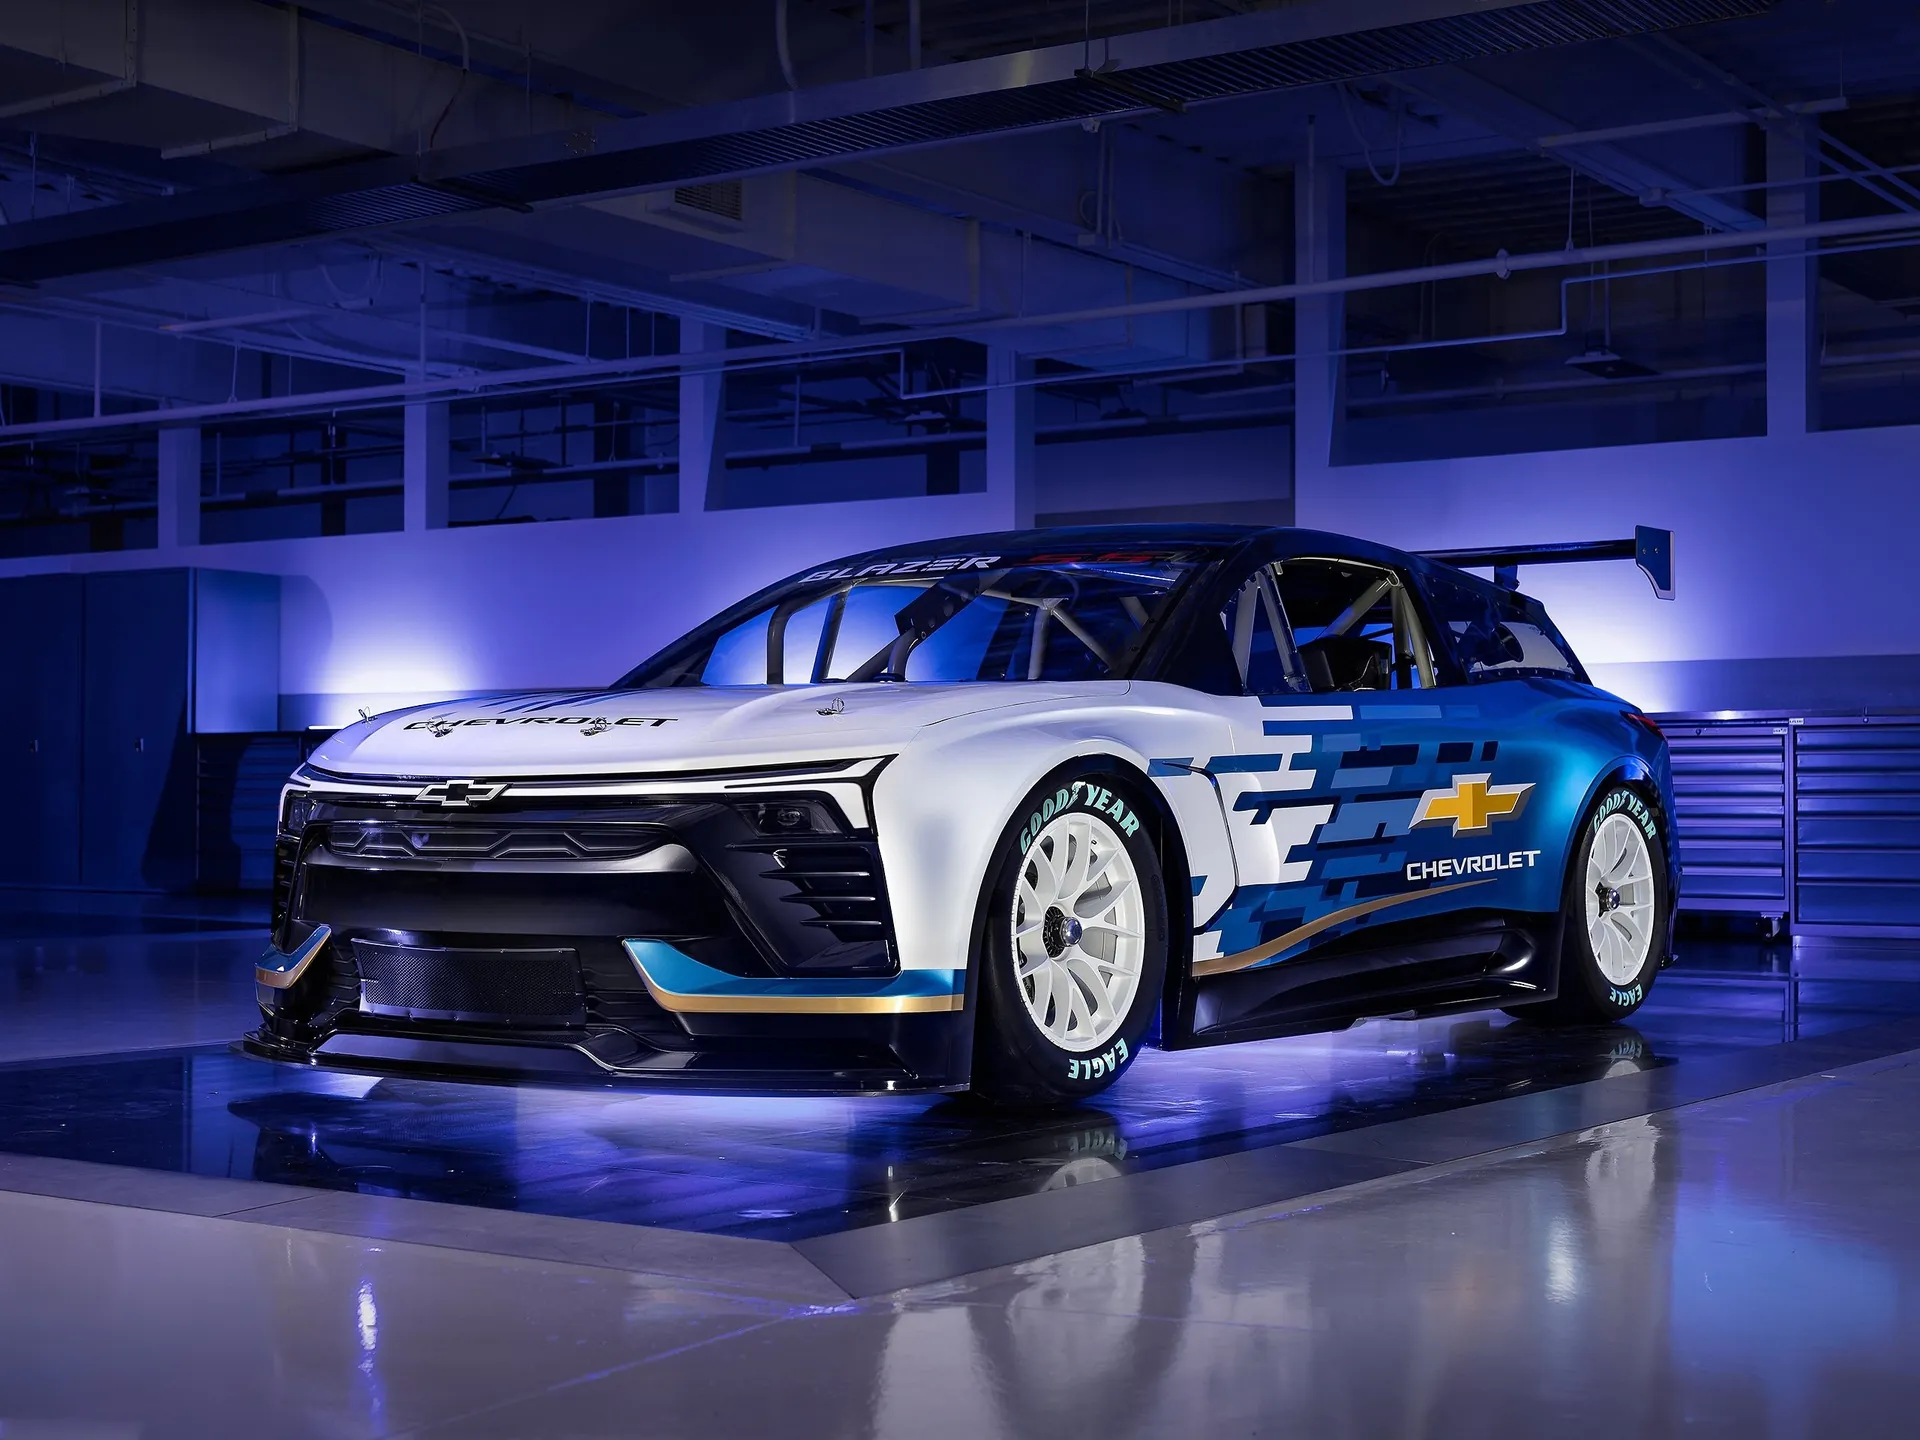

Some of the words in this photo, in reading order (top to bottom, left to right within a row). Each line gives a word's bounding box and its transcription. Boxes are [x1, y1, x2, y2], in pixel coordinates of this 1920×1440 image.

[797, 556, 1002, 583] BLAZER
[1020, 783, 1140, 855] GOODYEAR
[1406, 850, 1541, 881] CHEVROLET
[1609, 983, 1643, 1007] EAGLE
[1067, 1038, 1129, 1080] EAGLE
